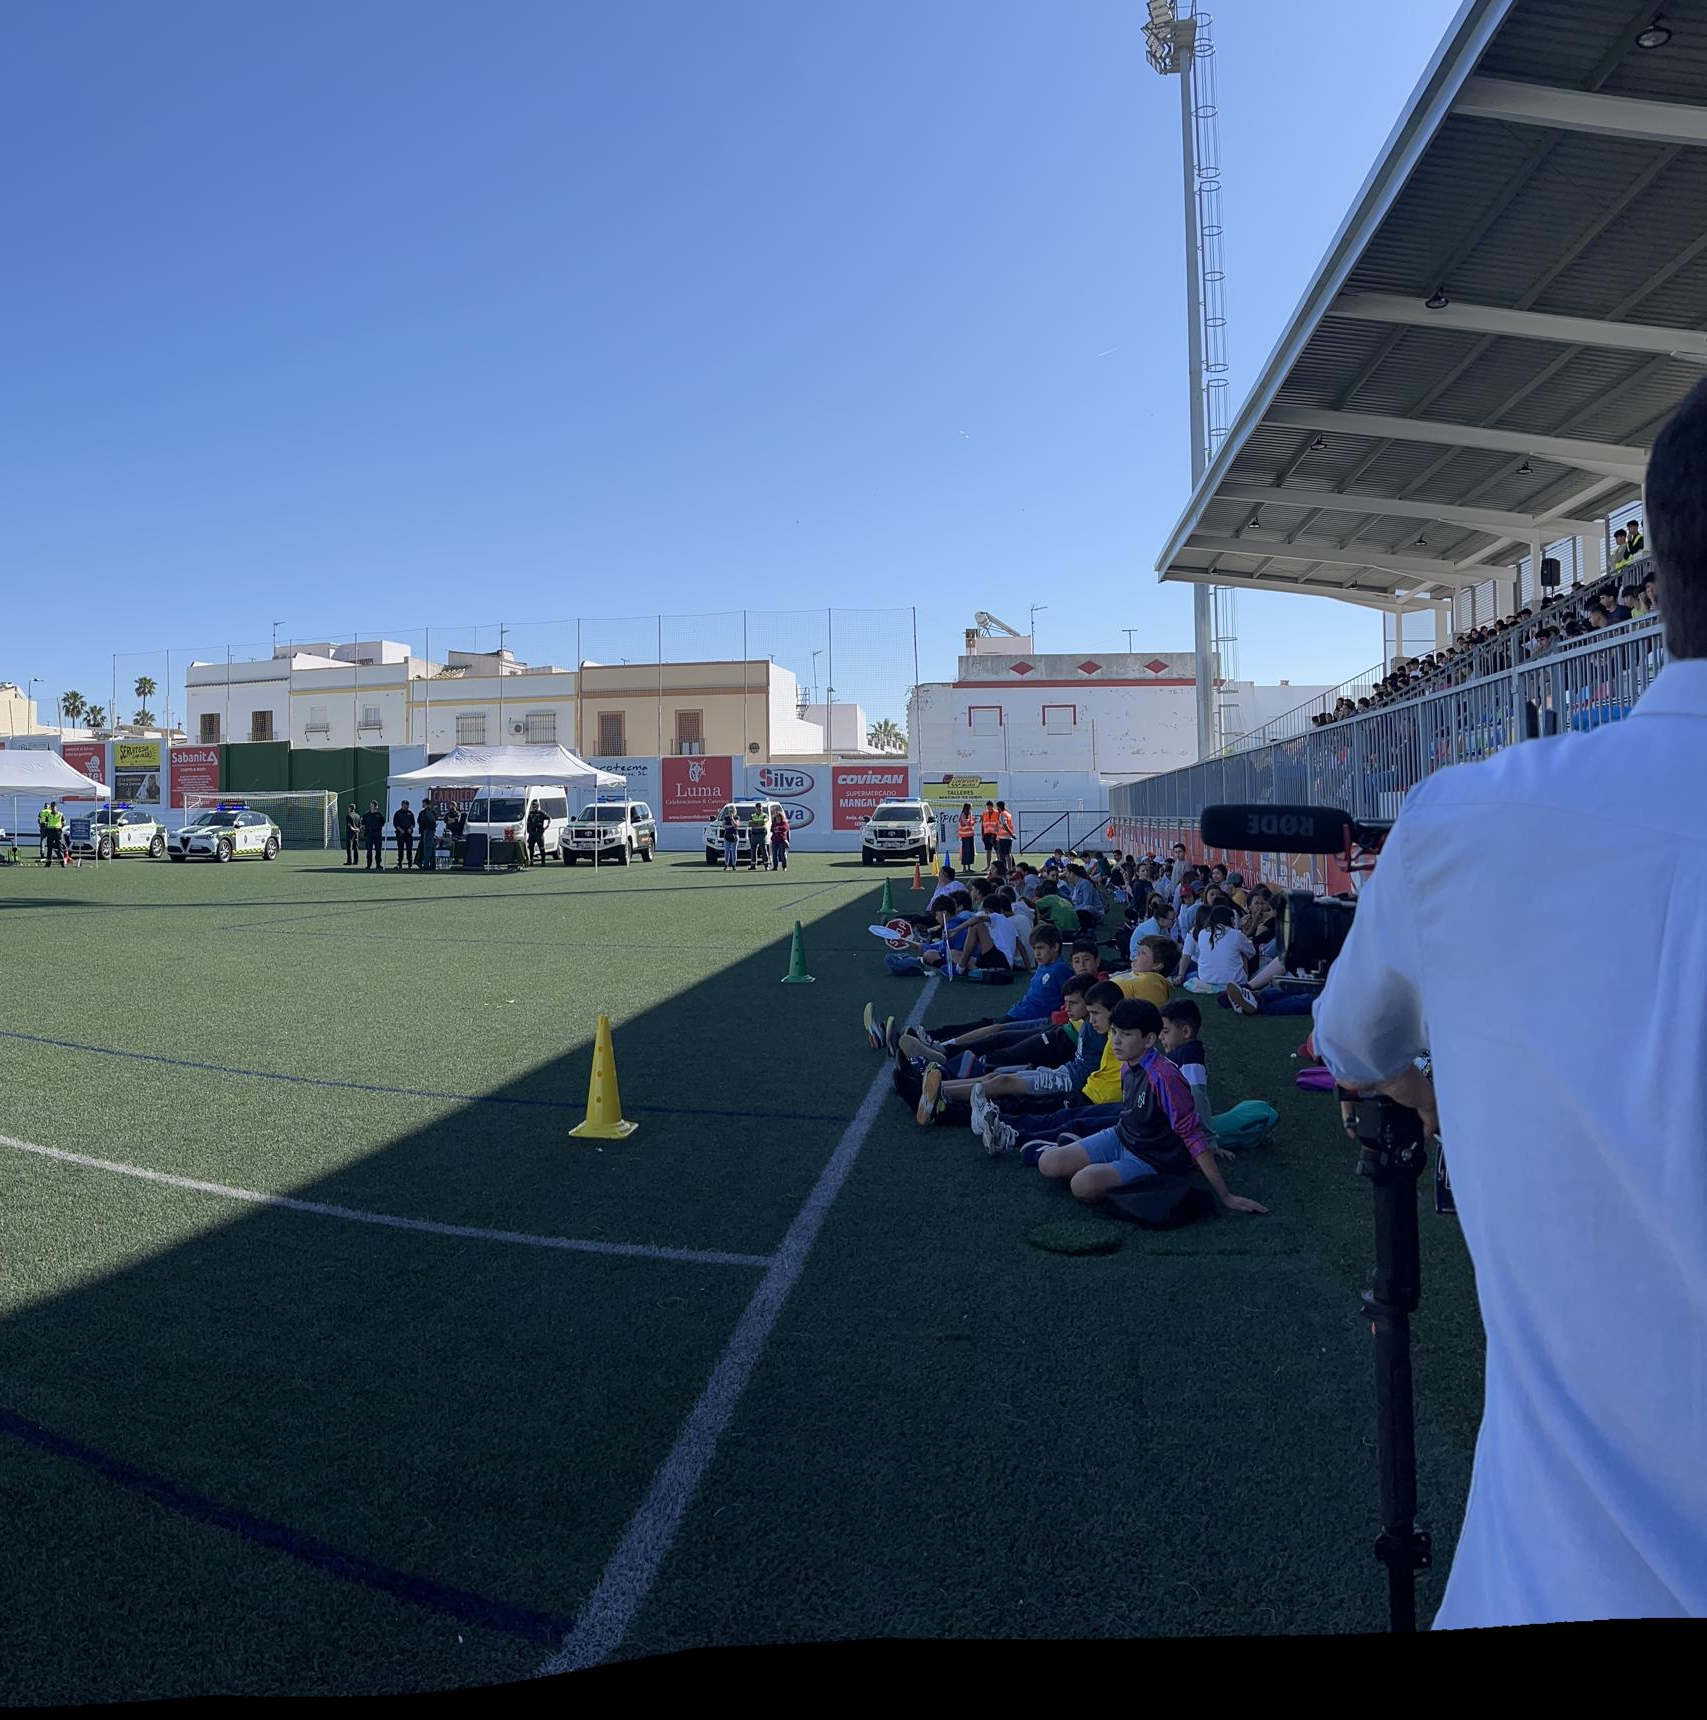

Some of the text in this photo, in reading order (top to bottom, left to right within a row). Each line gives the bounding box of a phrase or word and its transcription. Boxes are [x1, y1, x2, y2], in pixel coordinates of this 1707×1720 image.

[759, 768, 804, 788] Silva
[676, 783, 722, 797] Luma
[1247, 813, 1315, 837] RØDE
